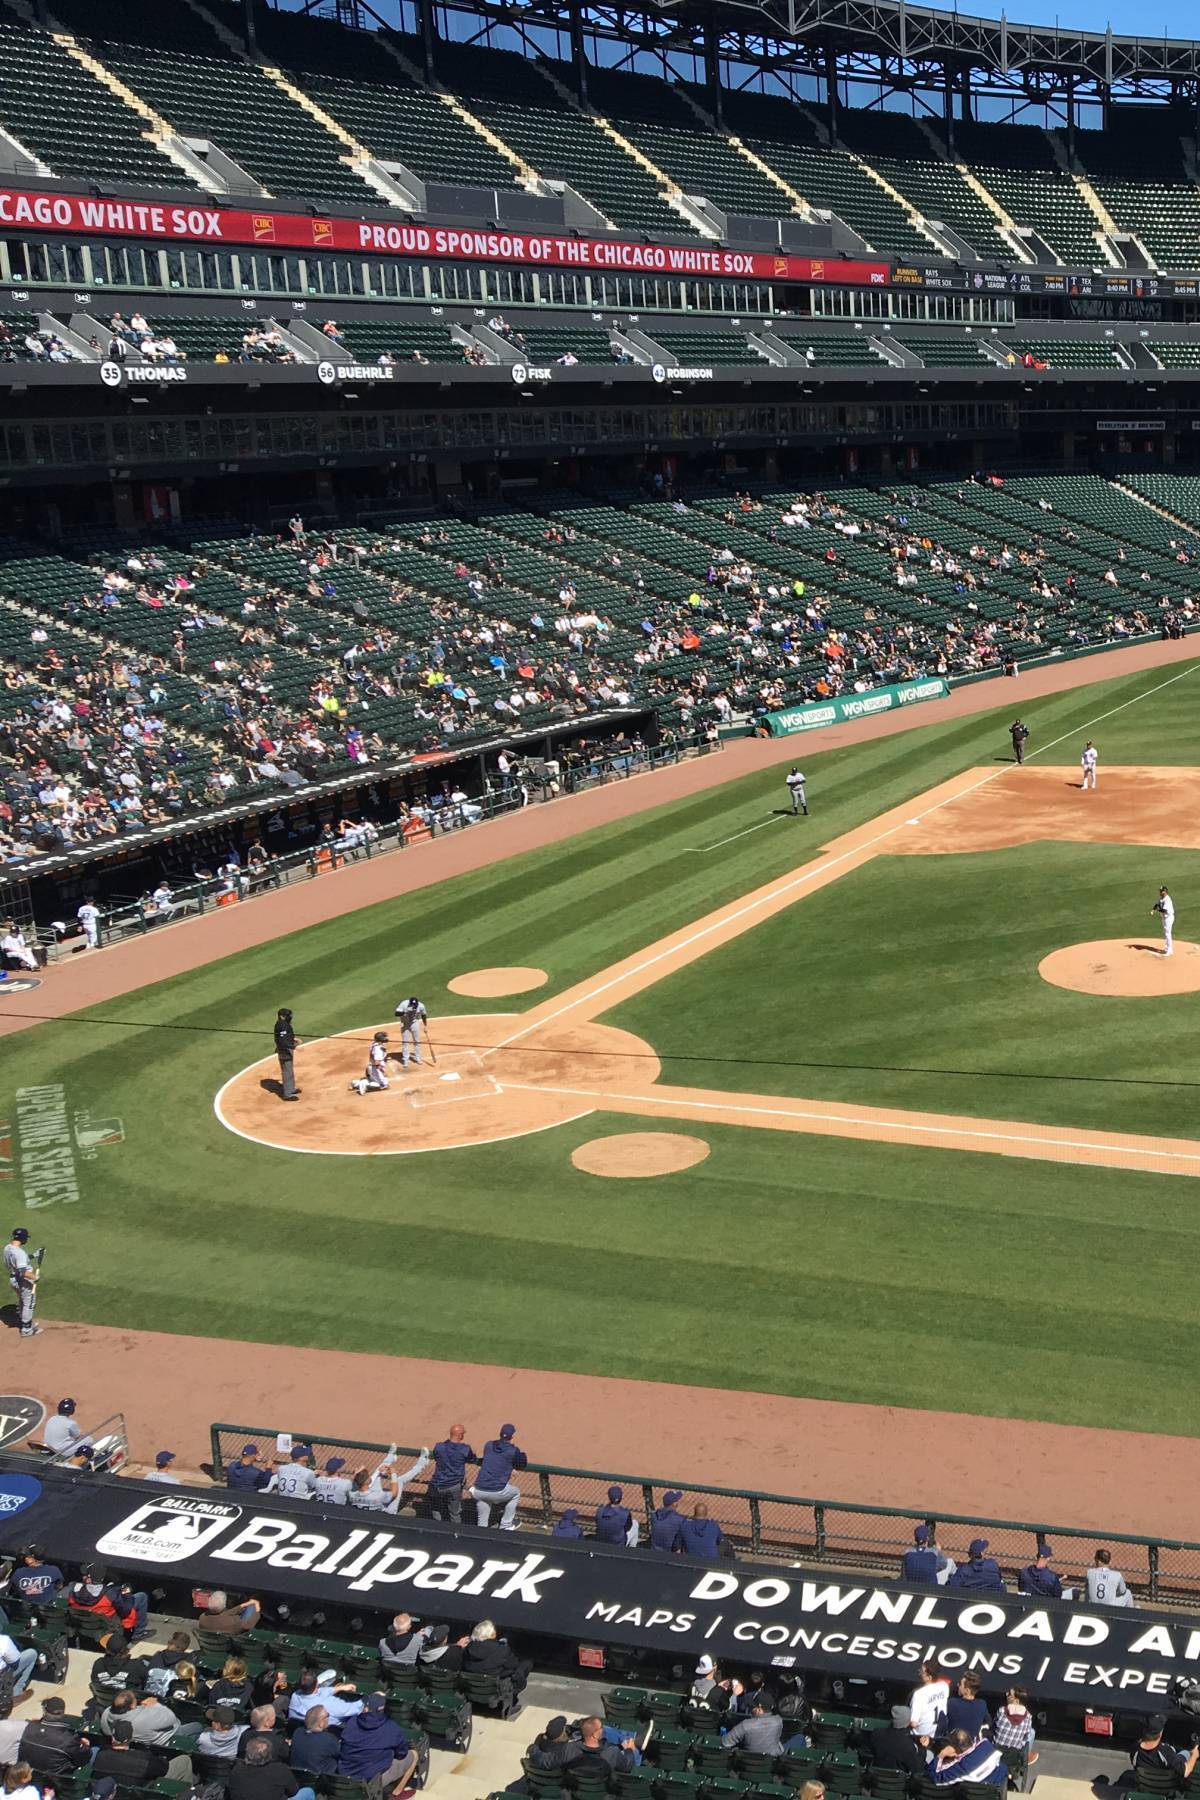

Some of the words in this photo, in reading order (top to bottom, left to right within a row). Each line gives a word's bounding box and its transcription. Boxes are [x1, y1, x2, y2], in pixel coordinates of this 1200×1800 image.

[79, 201, 165, 231] WHITE
[171, 209, 222, 236] SOX
[254, 218, 273, 228] CIBC
[314, 222, 331, 232] CIBC
[359, 225, 430, 250] PROUD
[436, 231, 524, 257] SPONSOR
[529, 238, 551, 259] OF
[556, 241, 589, 262] THE
[595, 244, 665, 267] CHICAGO
[669, 250, 720, 272] WHITE
[724, 255, 754, 273] SOX
[870, 273, 884, 283] FDIC
[896, 268, 918, 276] RUNNERS
[925, 269, 938, 277] RAYS
[985, 275, 1007, 283] NATIONAL
[1021, 275, 1031, 283] ATL
[911, 276, 923, 284] BASE
[925, 279, 941, 287] WHITE
[987, 281, 1005, 289] LEAGUE
[103, 368, 118, 379] 35
[125, 367, 186, 381] THOMAS
[320, 367, 333, 378] 56
[337, 366, 393, 379] BUEHRLE
[514, 368, 524, 379] 72
[528, 368, 551, 379] FISK
[654, 369, 664, 378] 42
[667, 368, 712, 379] ROBINSON
[897, 688, 921, 703] WGN
[920, 682, 942, 696] SPORTS
[841, 700, 868, 716] WGN
[867, 696, 891, 709] SPORTS
[778, 712, 806, 728] WGN
[808, 708, 835, 721] SPORTS
[16, 1084, 70, 1148] OPENING
[21, 1147, 80, 1209] SERIES
[280, 1478, 296, 1493] 33
[160, 1499, 233, 1515] BALLPARK
[123, 1534, 181, 1549] MLB.com
[209, 1516, 565, 1606] Ballpark
[1096, 1583, 1106, 1599] 8
[689, 1571, 1110, 1647] DOWNLOAD
[585, 1602, 696, 1632] MAPS
[732, 1621, 1024, 1674] CONCESSIONS
